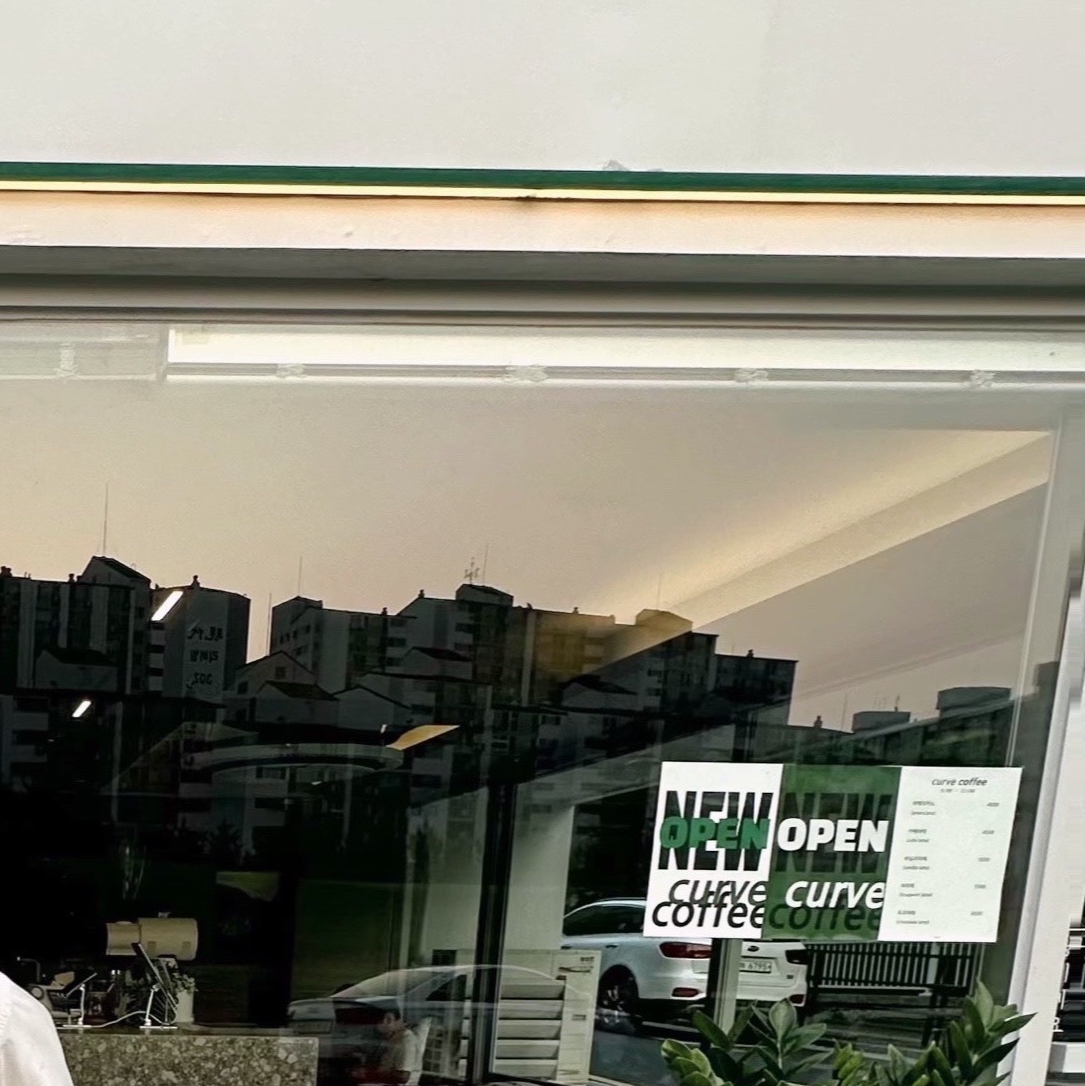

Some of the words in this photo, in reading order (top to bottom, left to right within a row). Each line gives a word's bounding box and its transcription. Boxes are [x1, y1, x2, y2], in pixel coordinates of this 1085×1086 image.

[931, 778, 956, 786] curve
[958, 777, 988, 786] coffee
[658, 791, 773, 871] NEW
[660, 816, 770, 849] OPEN
[777, 817, 889, 852] OPEN
[652, 891, 765, 928] coffee
[668, 880, 767, 905] curve
[785, 880, 885, 909] curve
[769, 893, 881, 931] coffee
